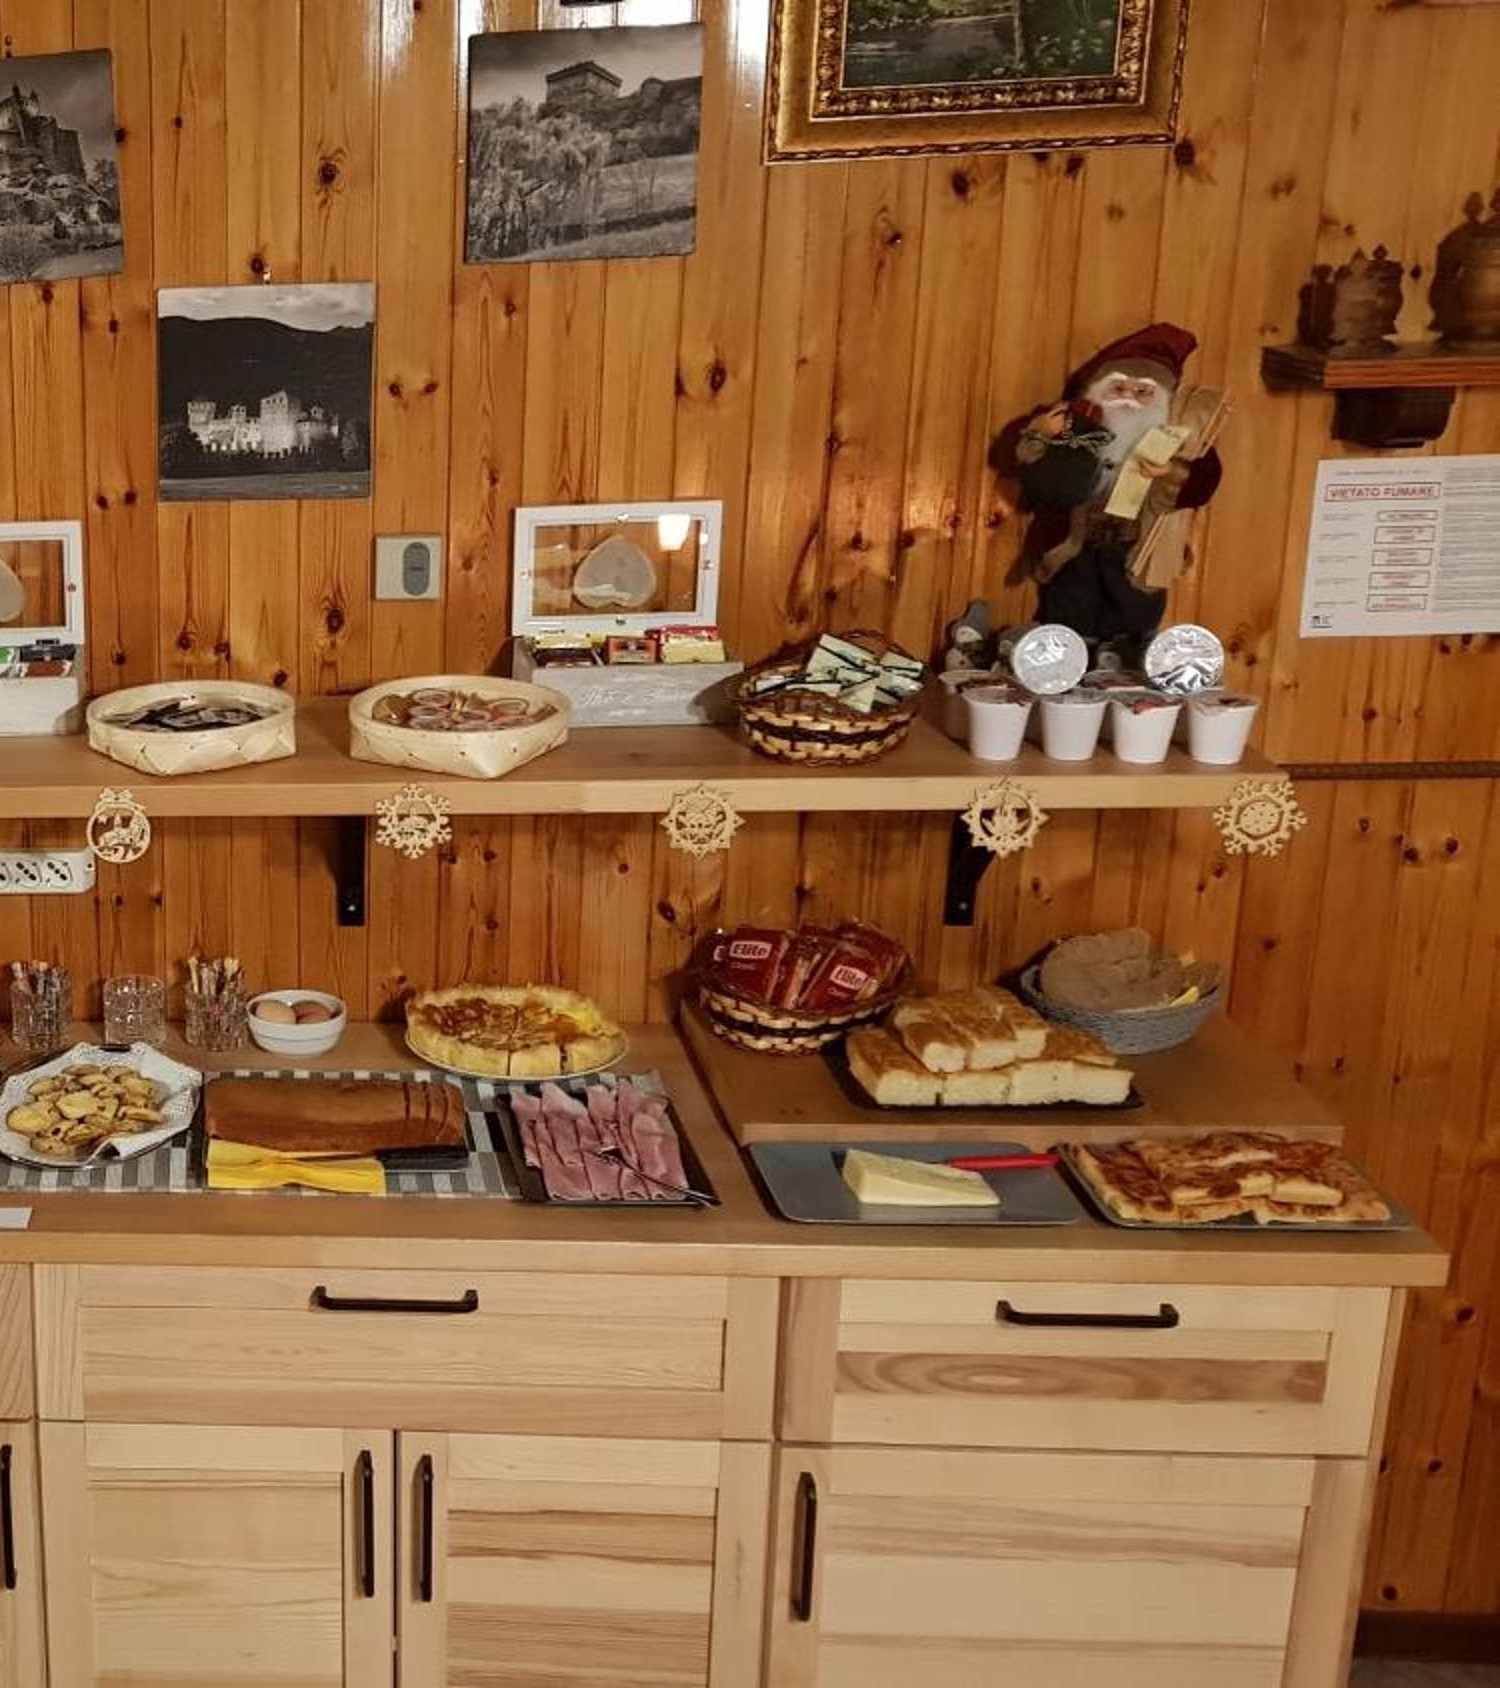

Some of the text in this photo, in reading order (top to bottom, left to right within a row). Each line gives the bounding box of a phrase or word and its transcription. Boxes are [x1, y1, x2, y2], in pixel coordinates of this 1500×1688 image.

[1329, 485, 1435, 498] VIETATO FUMARE
[731, 942, 769, 957] Elite
